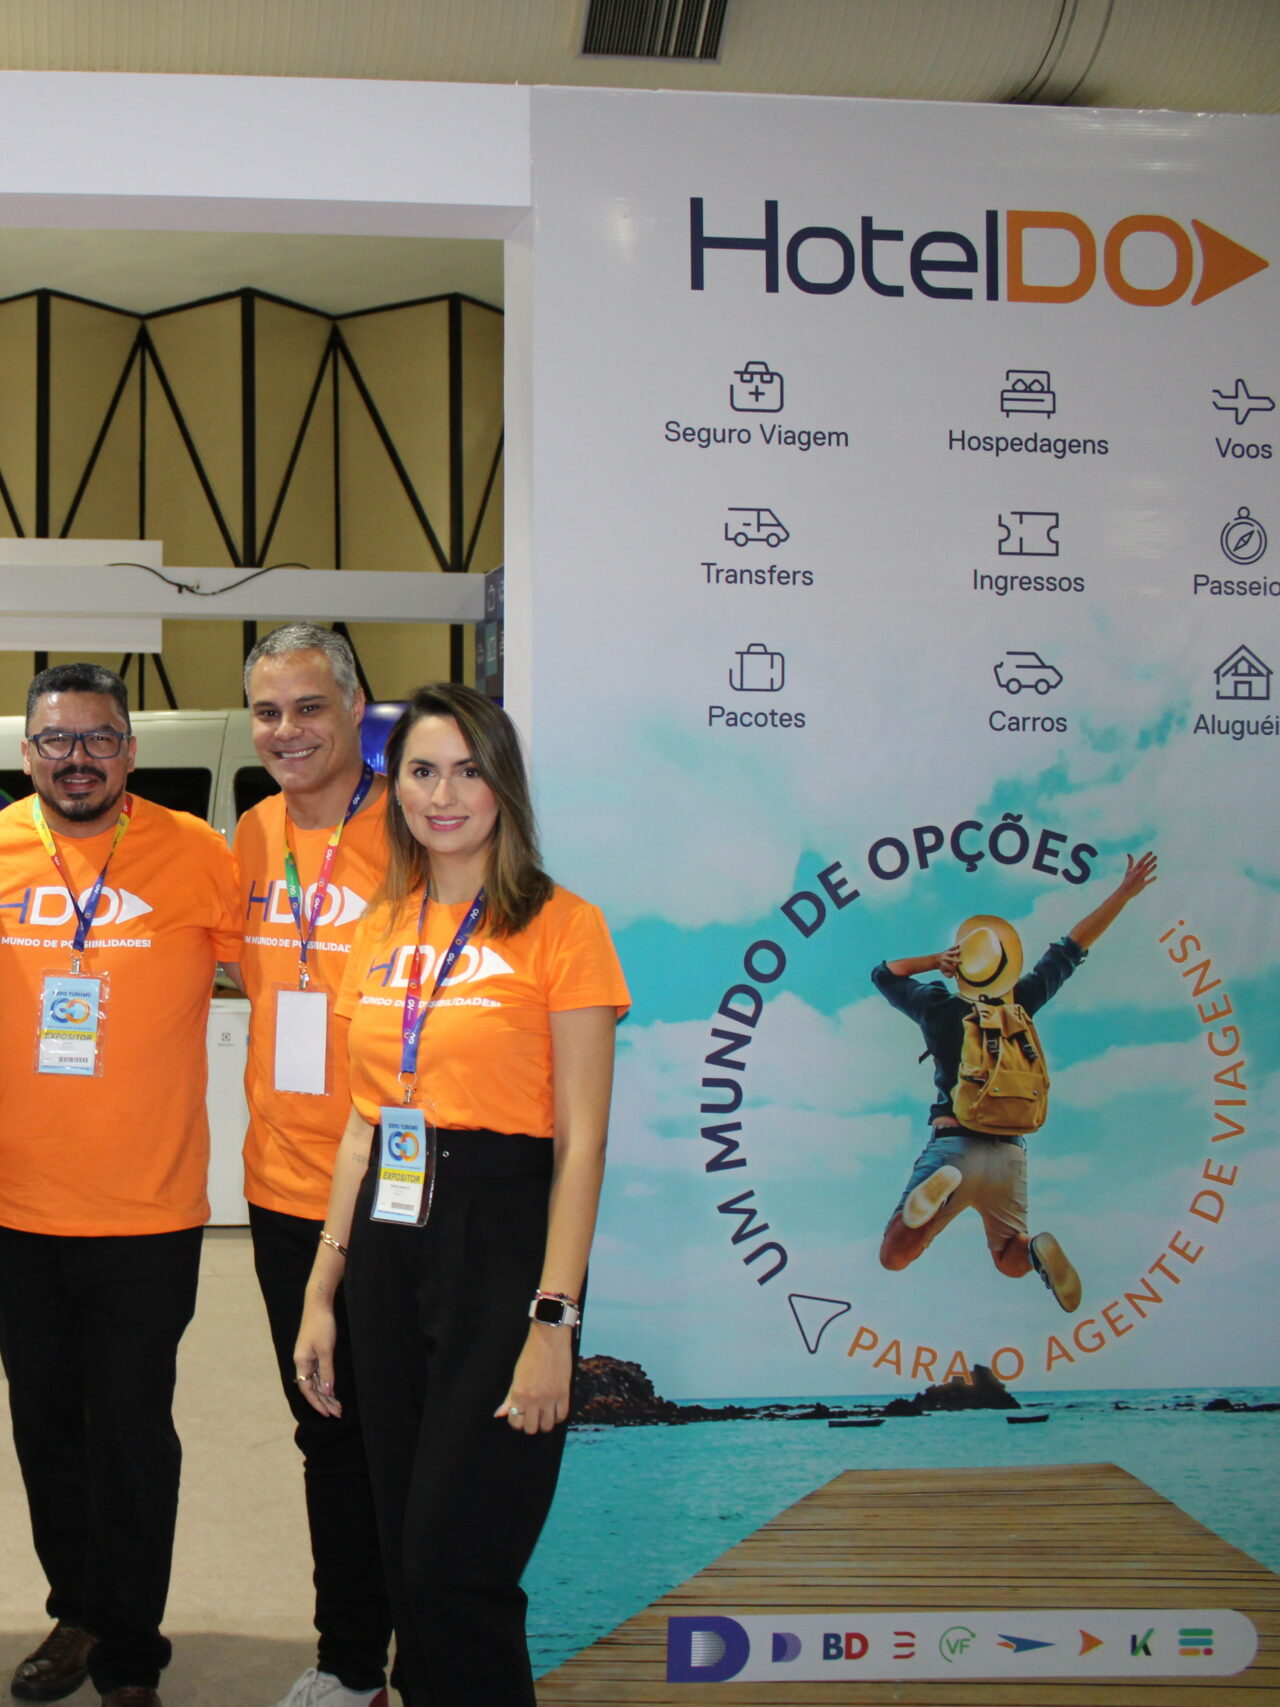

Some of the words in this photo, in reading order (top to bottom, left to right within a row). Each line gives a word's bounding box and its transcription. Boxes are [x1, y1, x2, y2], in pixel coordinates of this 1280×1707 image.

[689, 197, 1194, 307] HotelDO
[664, 420, 752, 449] Seguro
[759, 423, 850, 451] Viagem
[948, 429, 1109, 459] Hospedagens
[1215, 438, 1273, 460] Voos
[700, 562, 814, 587] Transfers
[973, 569, 1085, 594] Ingressos
[707, 705, 806, 728] Pacotes
[989, 710, 1067, 733] Carros
[1193, 713, 1280, 741] Aluguéi
[868, 812, 1099, 886] OPÇÕES
[246, 880, 341, 926] HDO
[780, 860, 861, 939] DE
[2, 937, 41, 947] MUNDO
[43, 939, 58, 948] DE
[61, 938, 151, 949] POSIBILIDADES!
[366, 945, 480, 988] HDO
[44, 1032, 93, 1041] EXPOSITOR
[1158, 918, 1248, 1143] VIAGENS!
[700, 939, 787, 1174] MUNDO
[383, 1171, 421, 1183] EXPOSITOR
[1189, 1157, 1239, 1225] DE
[717, 1189, 789, 1286] UM
[1045, 1229, 1206, 1372] AGENTE
[847, 1325, 975, 1387] PARA
[992, 1347, 1025, 1381] O
[823, 1632, 869, 1661] BD
[946, 1638, 971, 1656] VF
[1131, 1628, 1155, 1656] K
